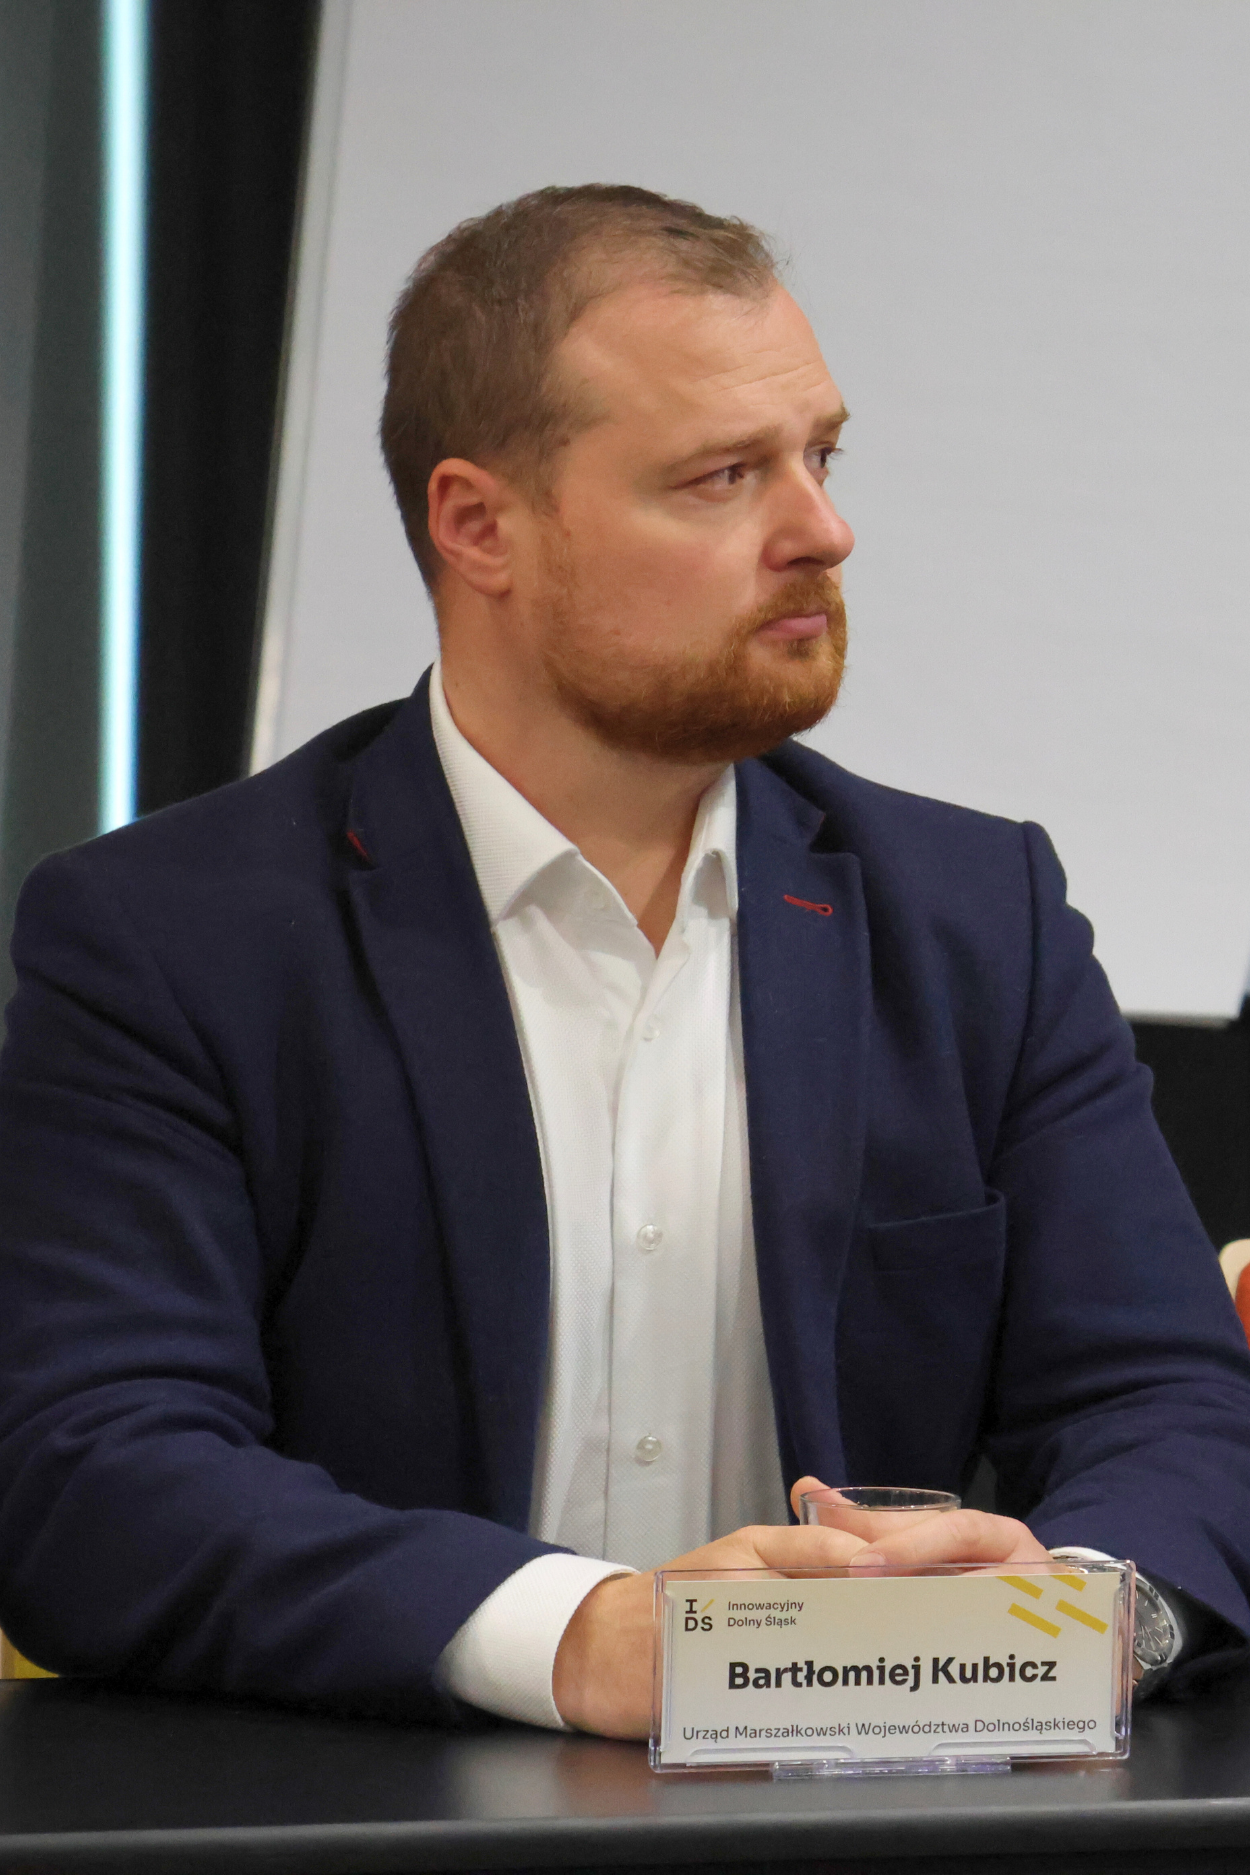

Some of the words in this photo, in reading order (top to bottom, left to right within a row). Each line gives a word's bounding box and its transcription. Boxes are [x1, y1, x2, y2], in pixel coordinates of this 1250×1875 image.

[728, 1600, 804, 1612] Innowacyjny
[728, 1617, 762, 1628] Dolny
[765, 1614, 796, 1628] Śląsk
[729, 1656, 921, 1692] Bartłomiej
[932, 1654, 1057, 1684] Kubicz
[683, 1726, 729, 1741] Urząd
[735, 1723, 850, 1738] Marszałkowski
[856, 1720, 969, 1738] Województwa
[975, 1717, 1096, 1734] Dolnośląskiego
